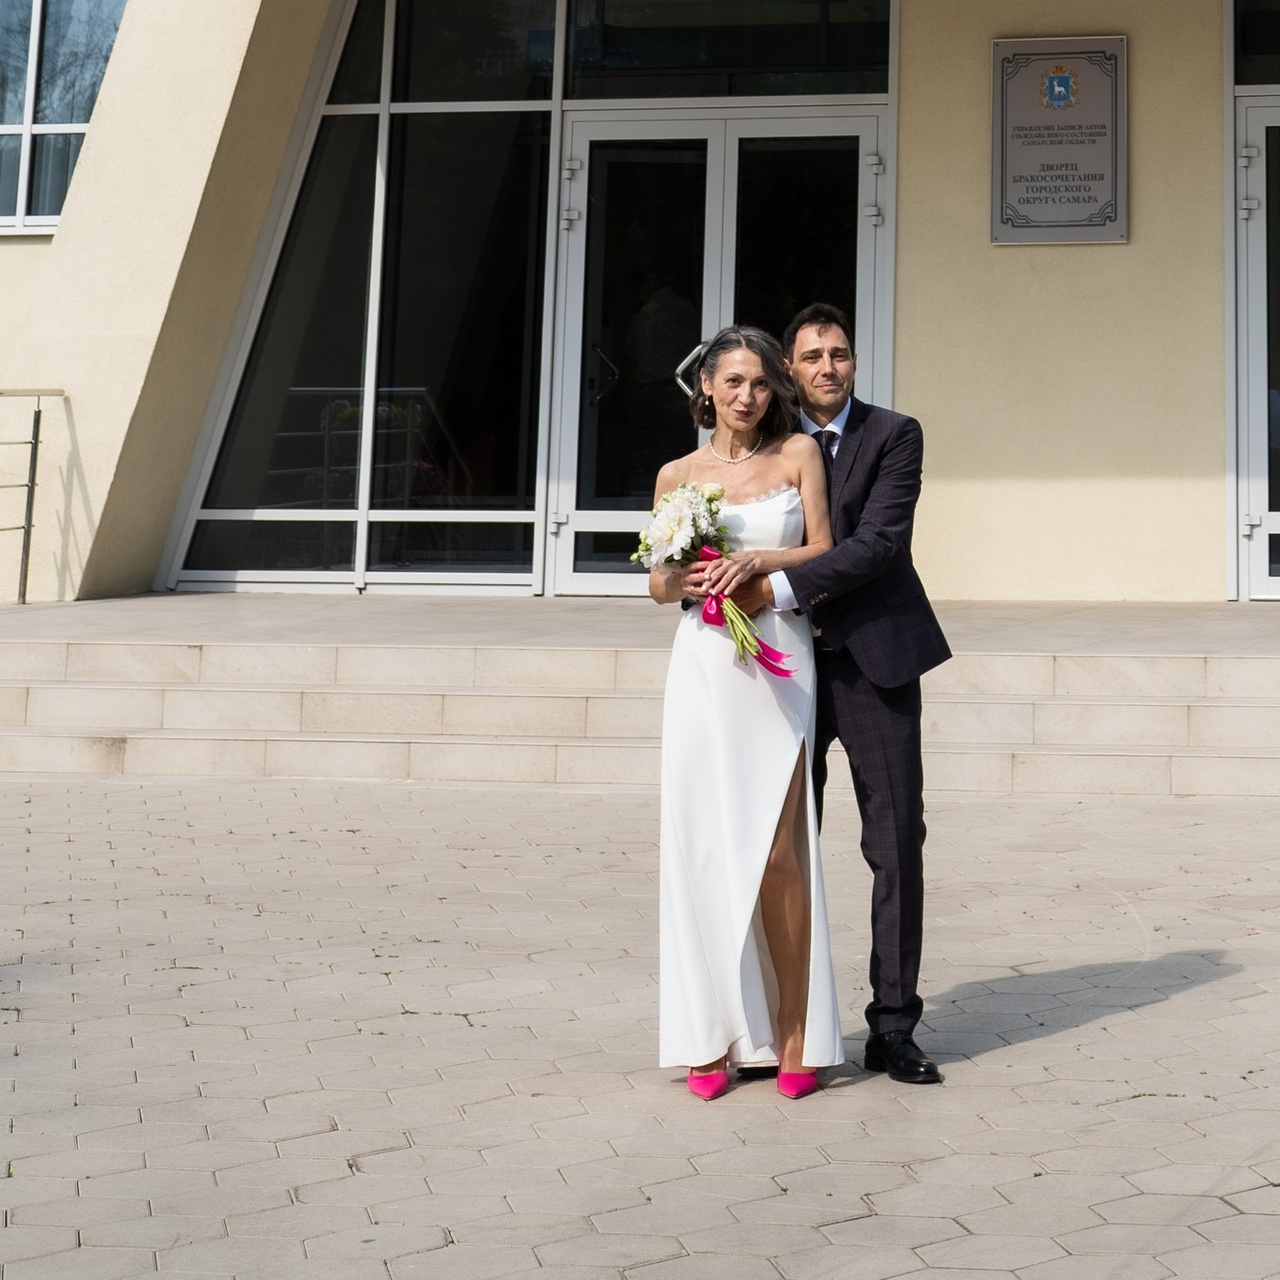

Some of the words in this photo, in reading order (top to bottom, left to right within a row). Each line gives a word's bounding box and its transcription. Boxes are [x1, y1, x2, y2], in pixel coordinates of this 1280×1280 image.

[1039, 163, 1078, 172] ДВОРЕЦ
[1012, 173, 1104, 183] БРАКОСОЧЕТАНИЯ
[1025, 185, 1091, 194] ГОРОДСКОГО
[1018, 196, 1056, 205] ОКРУГА
[1058, 195, 1098, 204] САМАРА
